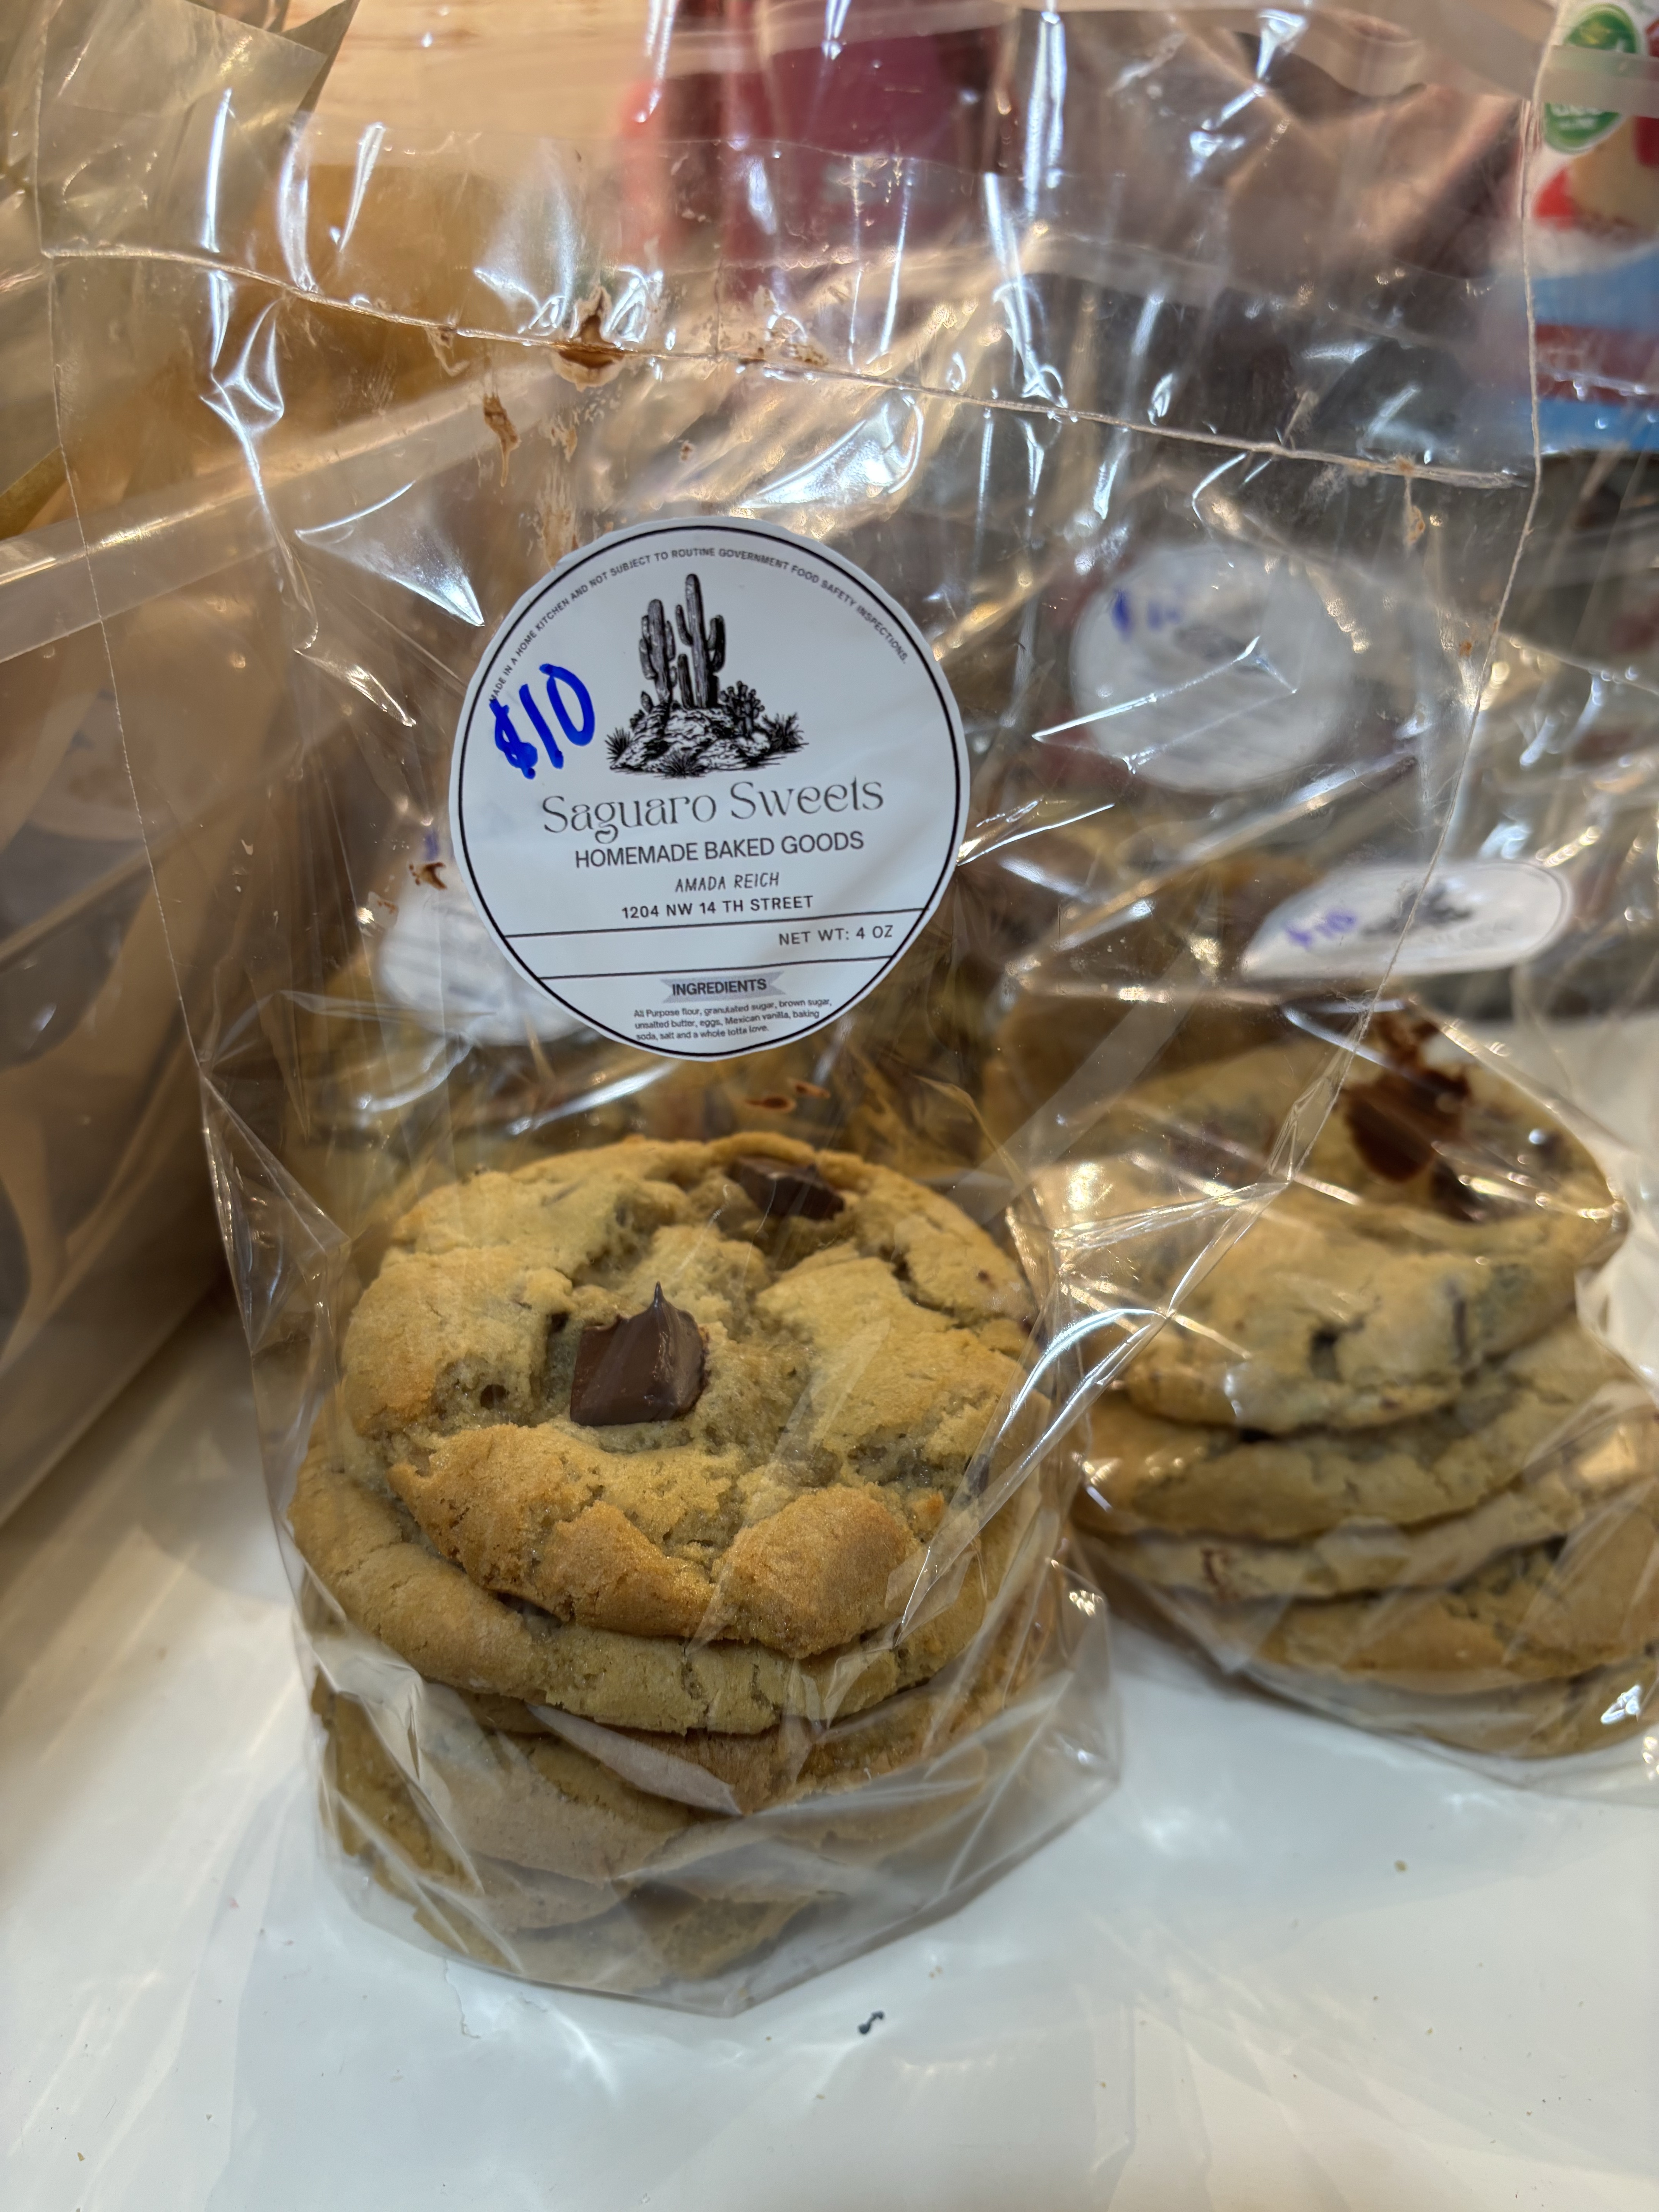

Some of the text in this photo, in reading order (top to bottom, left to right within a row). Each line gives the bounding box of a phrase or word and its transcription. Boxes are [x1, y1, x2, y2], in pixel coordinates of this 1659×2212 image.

[503, 665, 513, 677] IN
[511, 657, 518, 665] A
[515, 630, 537, 657] HOME
[535, 598, 570, 632] KITCHEN
[570, 584, 589, 601] AND
[589, 572, 608, 588] NOT
[610, 555, 650, 576] SUBJECT
[655, 551, 668, 562] TO
[672, 548, 715, 558] ROUTINE
[718, 548, 789, 570] GOVERNMENT
[791, 565, 819, 584] FOOD
[821, 580, 857, 606] SAFETY
[489, 663, 596, 780] $10
[542, 776, 884, 844] Saguaro Sweets
[575, 831, 865, 868] HOMEMADE BAKED GOODS
[675, 871, 780, 893] AMADA REICH
[622, 895, 814, 919] 1204 NW 14 TH STREET
[779, 924, 894, 946] NET WT: 4 OZ
[672, 978, 767, 996] INGREDIENTS
[635, 1010, 820, 1029] unsalted butter, eggs, Mexican vanilla, baking
[646, 1008, 679, 1019] Purpose
[682, 1008, 702, 1017] flour,
[704, 1005, 749, 1017] granulated
[751, 1002, 777, 1012] sugar,
[807, 998, 832, 1007] sugar,
[635, 1032, 658, 1041] soda,
[700, 1029, 726, 1038] whole
[728, 1027, 747, 1036] lotta
[749, 1024, 769, 1034] love.
